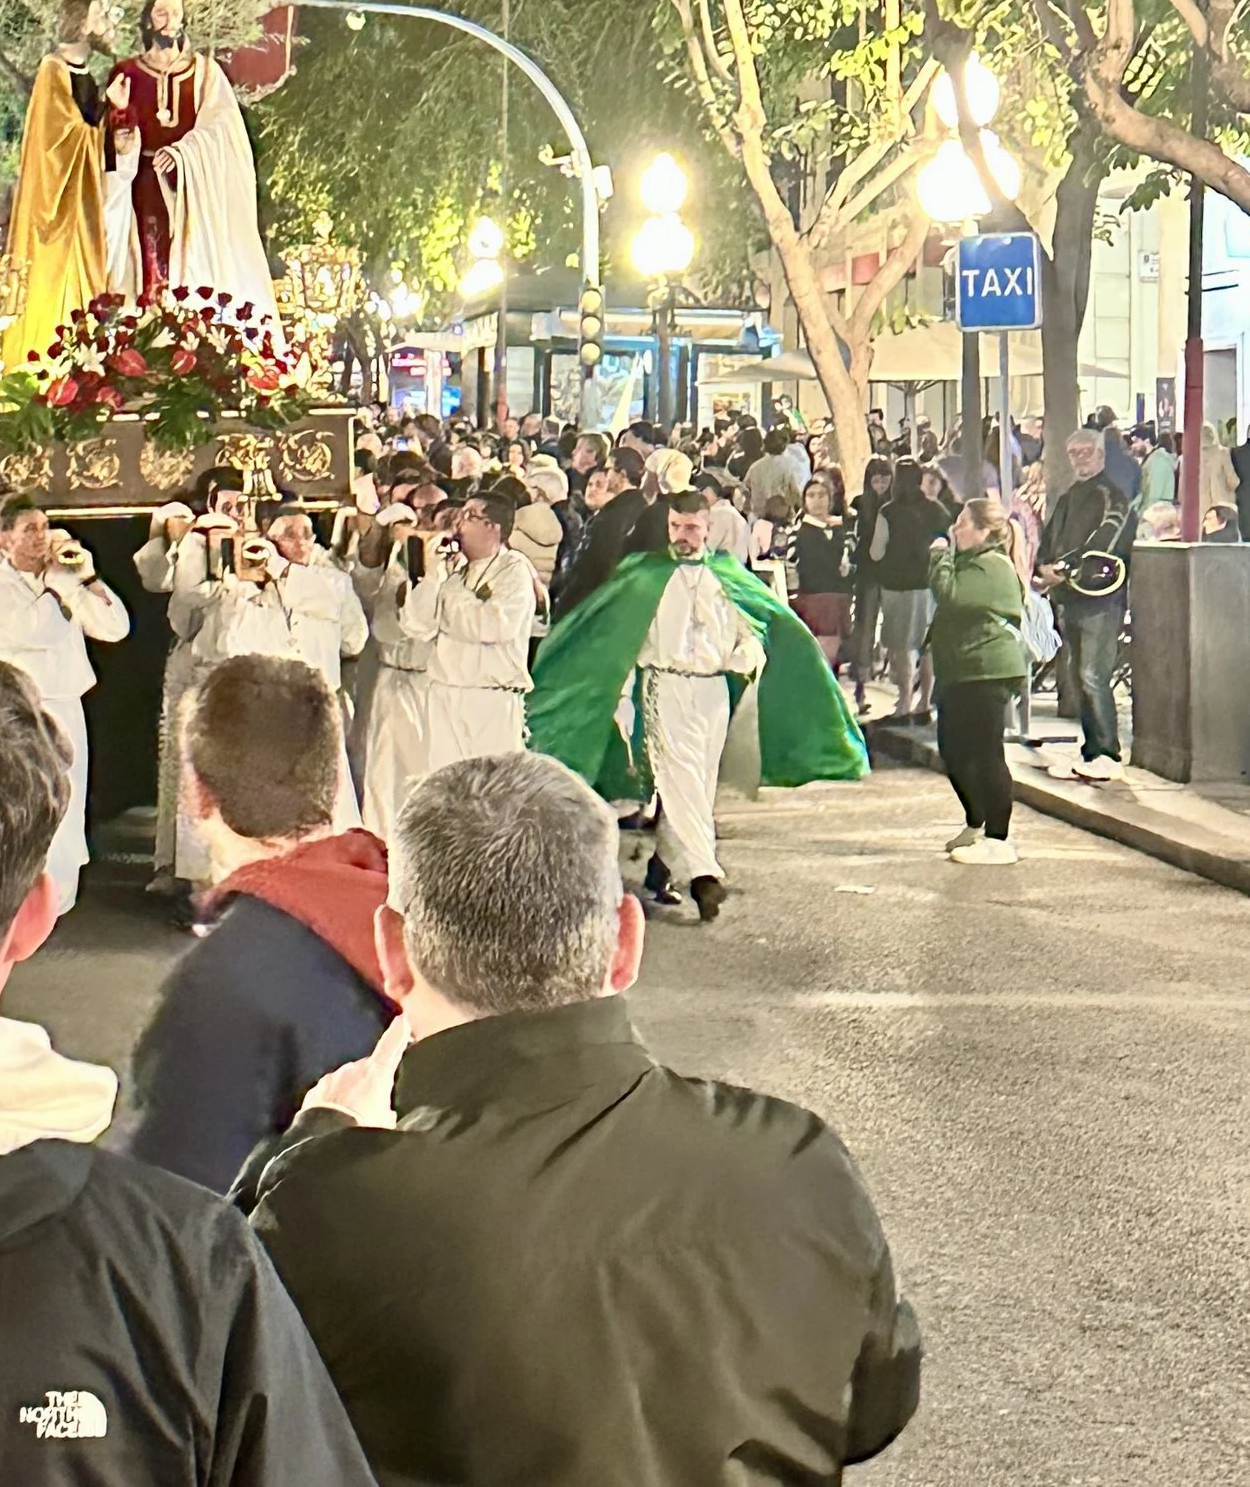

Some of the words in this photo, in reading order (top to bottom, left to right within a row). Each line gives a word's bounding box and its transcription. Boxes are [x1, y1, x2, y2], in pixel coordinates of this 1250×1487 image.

[962, 267, 1033, 297] TAXI
[45, 1391, 78, 1407] THE
[19, 1406, 79, 1424] NORTH
[36, 1421, 79, 1438] FACE
